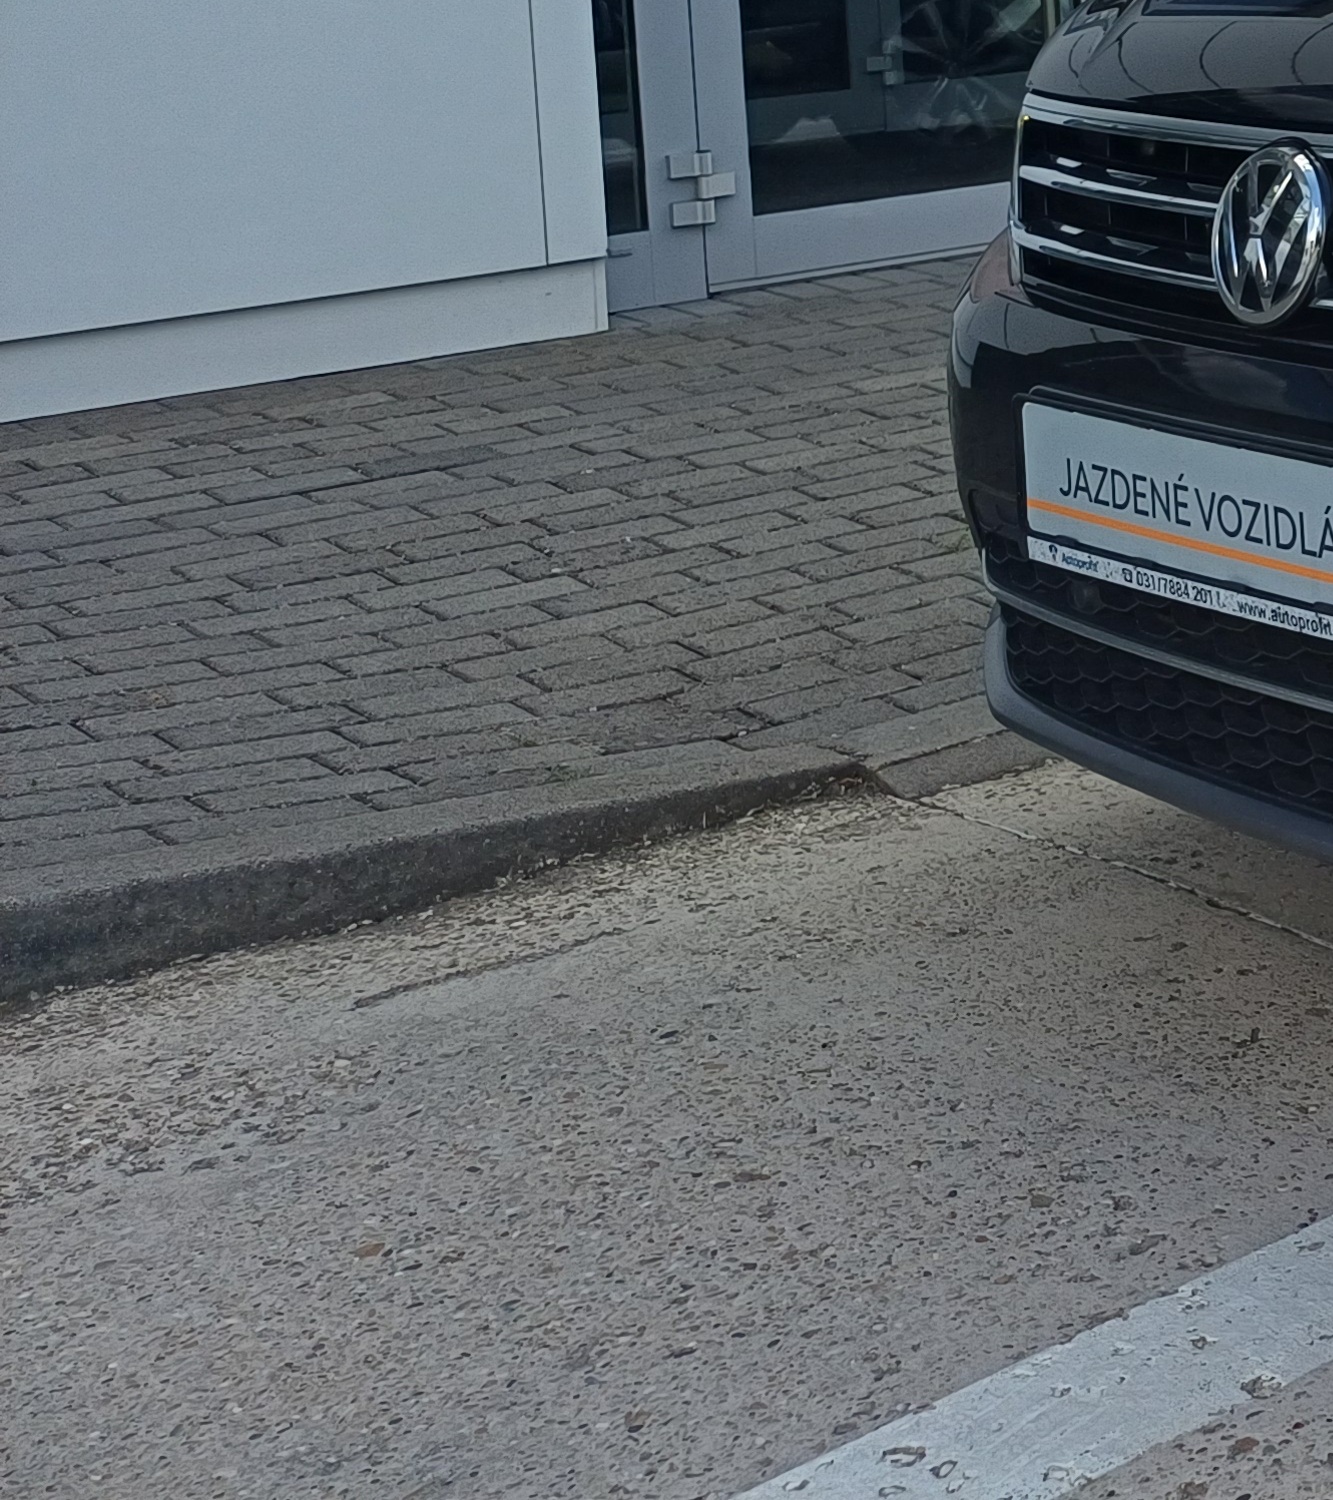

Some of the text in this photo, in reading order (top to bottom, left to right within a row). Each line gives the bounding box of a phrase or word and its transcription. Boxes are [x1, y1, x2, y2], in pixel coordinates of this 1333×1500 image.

[1059, 458, 1191, 526] JAZDENÉ
[1136, 572, 1213, 605] 031/7884 201
